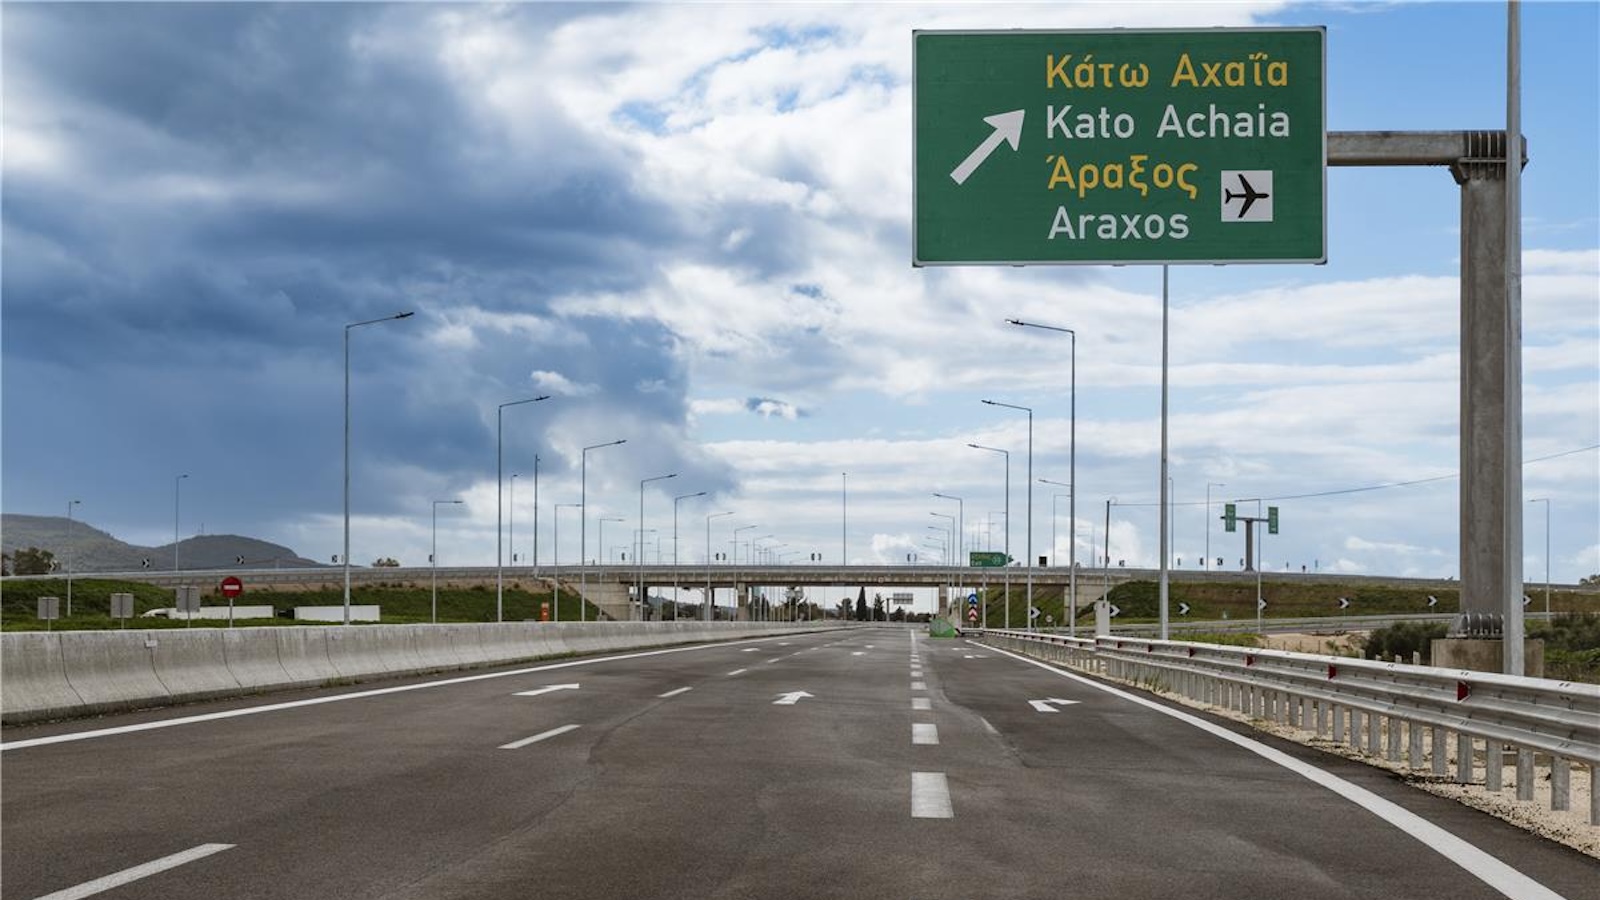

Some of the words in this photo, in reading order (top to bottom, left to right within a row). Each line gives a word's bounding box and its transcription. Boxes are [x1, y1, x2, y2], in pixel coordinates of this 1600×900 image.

[1046, 54, 1149, 88] Κάτω
[1171, 53, 1289, 87] Αχαΐα
[1046, 105, 1135, 139] Kato
[1156, 104, 1290, 138] Achaia
[1046, 155, 1198, 199] Άραξος
[1048, 206, 1190, 240] Araxos
